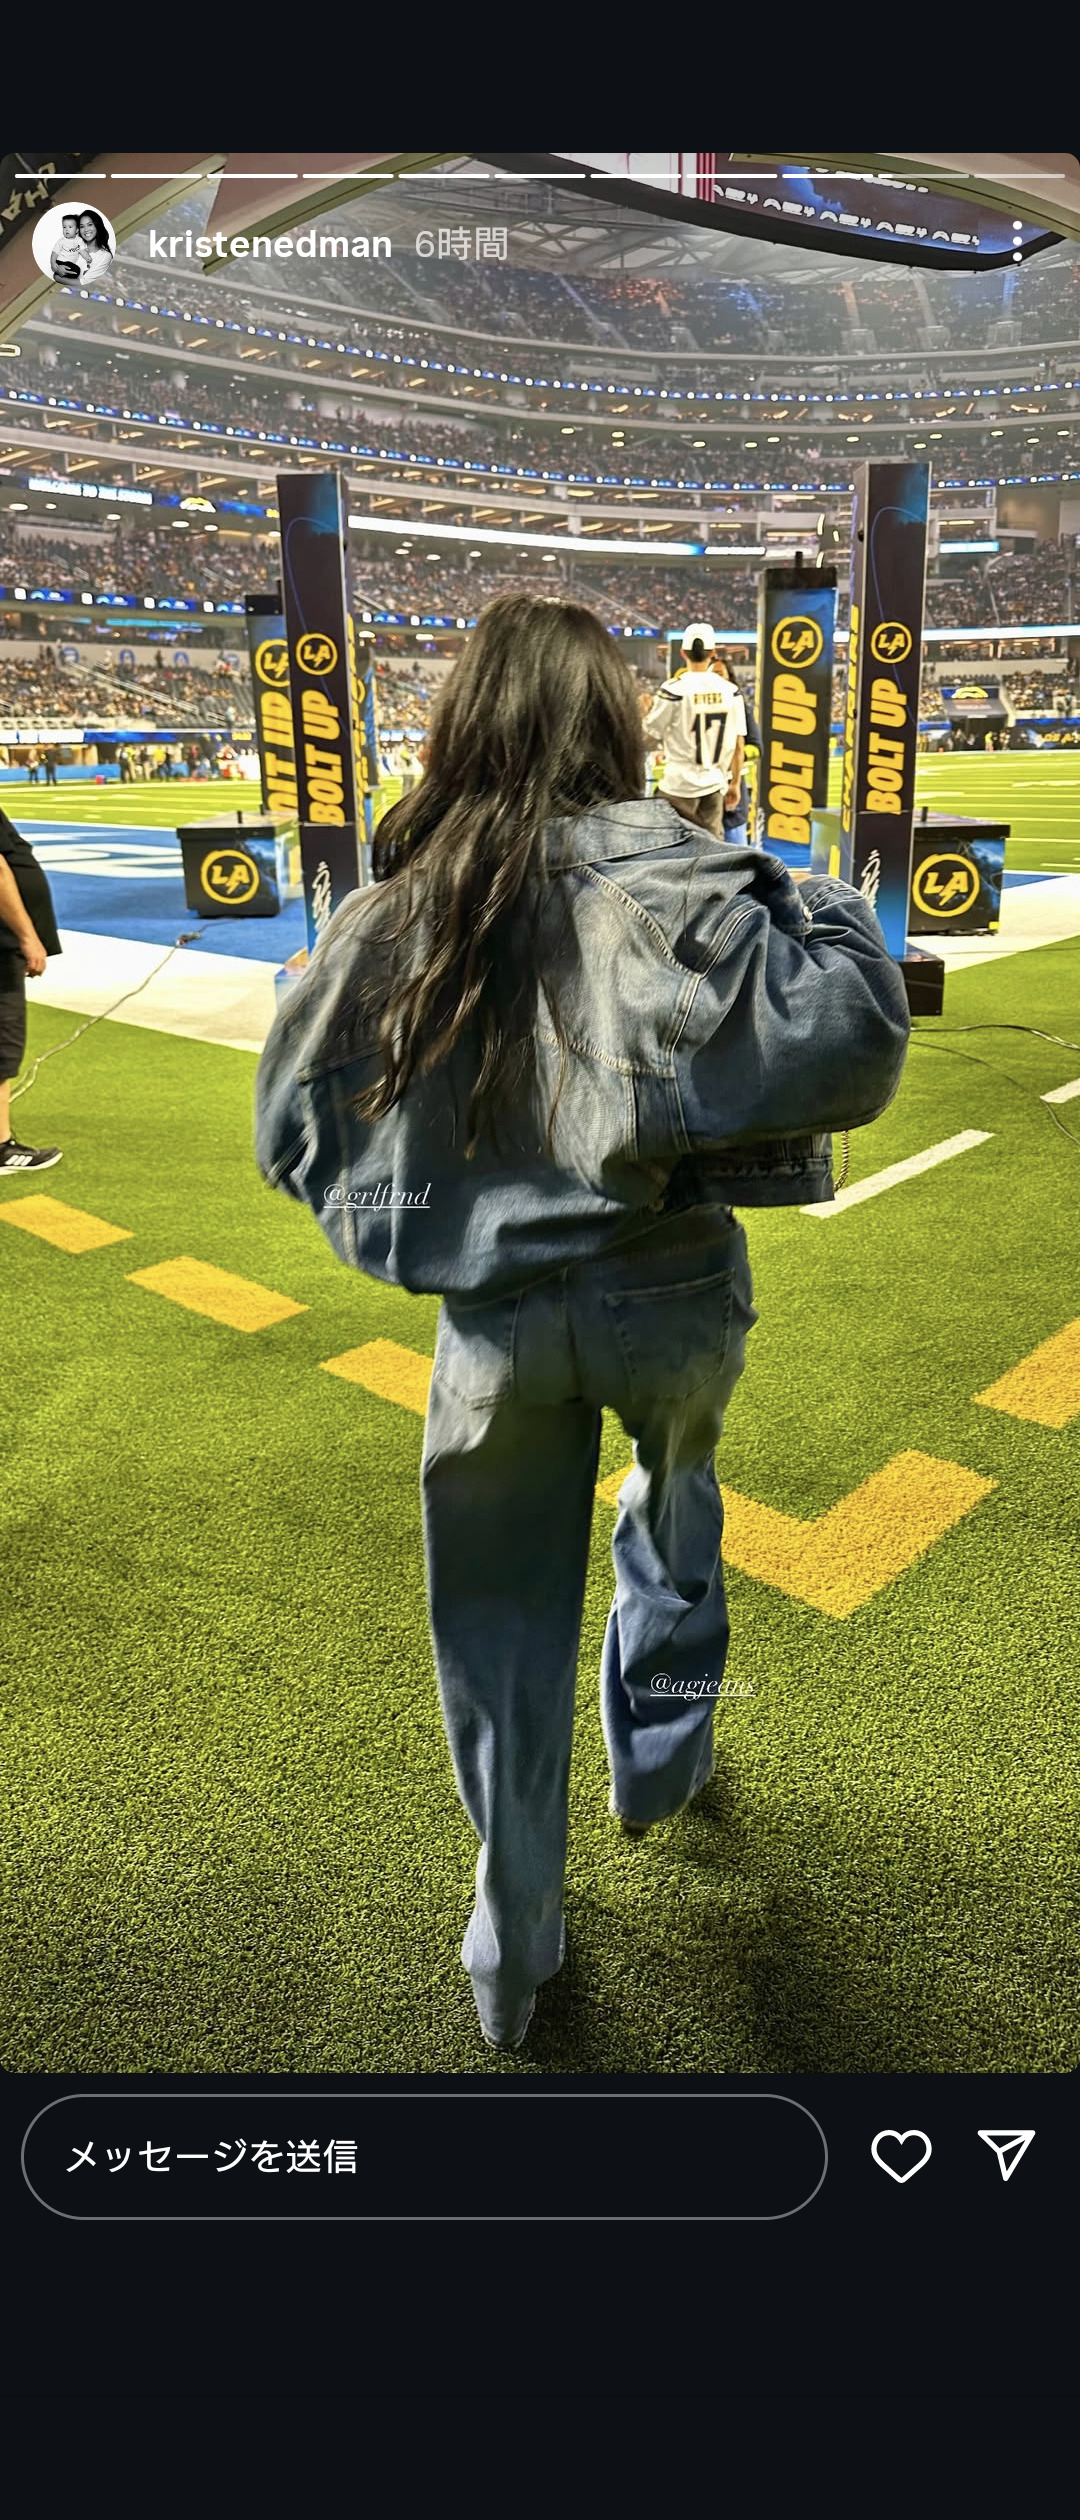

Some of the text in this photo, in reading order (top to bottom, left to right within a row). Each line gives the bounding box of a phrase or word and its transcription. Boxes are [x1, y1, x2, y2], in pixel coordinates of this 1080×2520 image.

[301, 690, 340, 739] UP
[869, 678, 907, 728] UP
[691, 711, 729, 765] 17
[767, 673, 817, 845] BOLT UP
[305, 744, 345, 826] BOLT
[866, 732, 905, 815] BOLT
